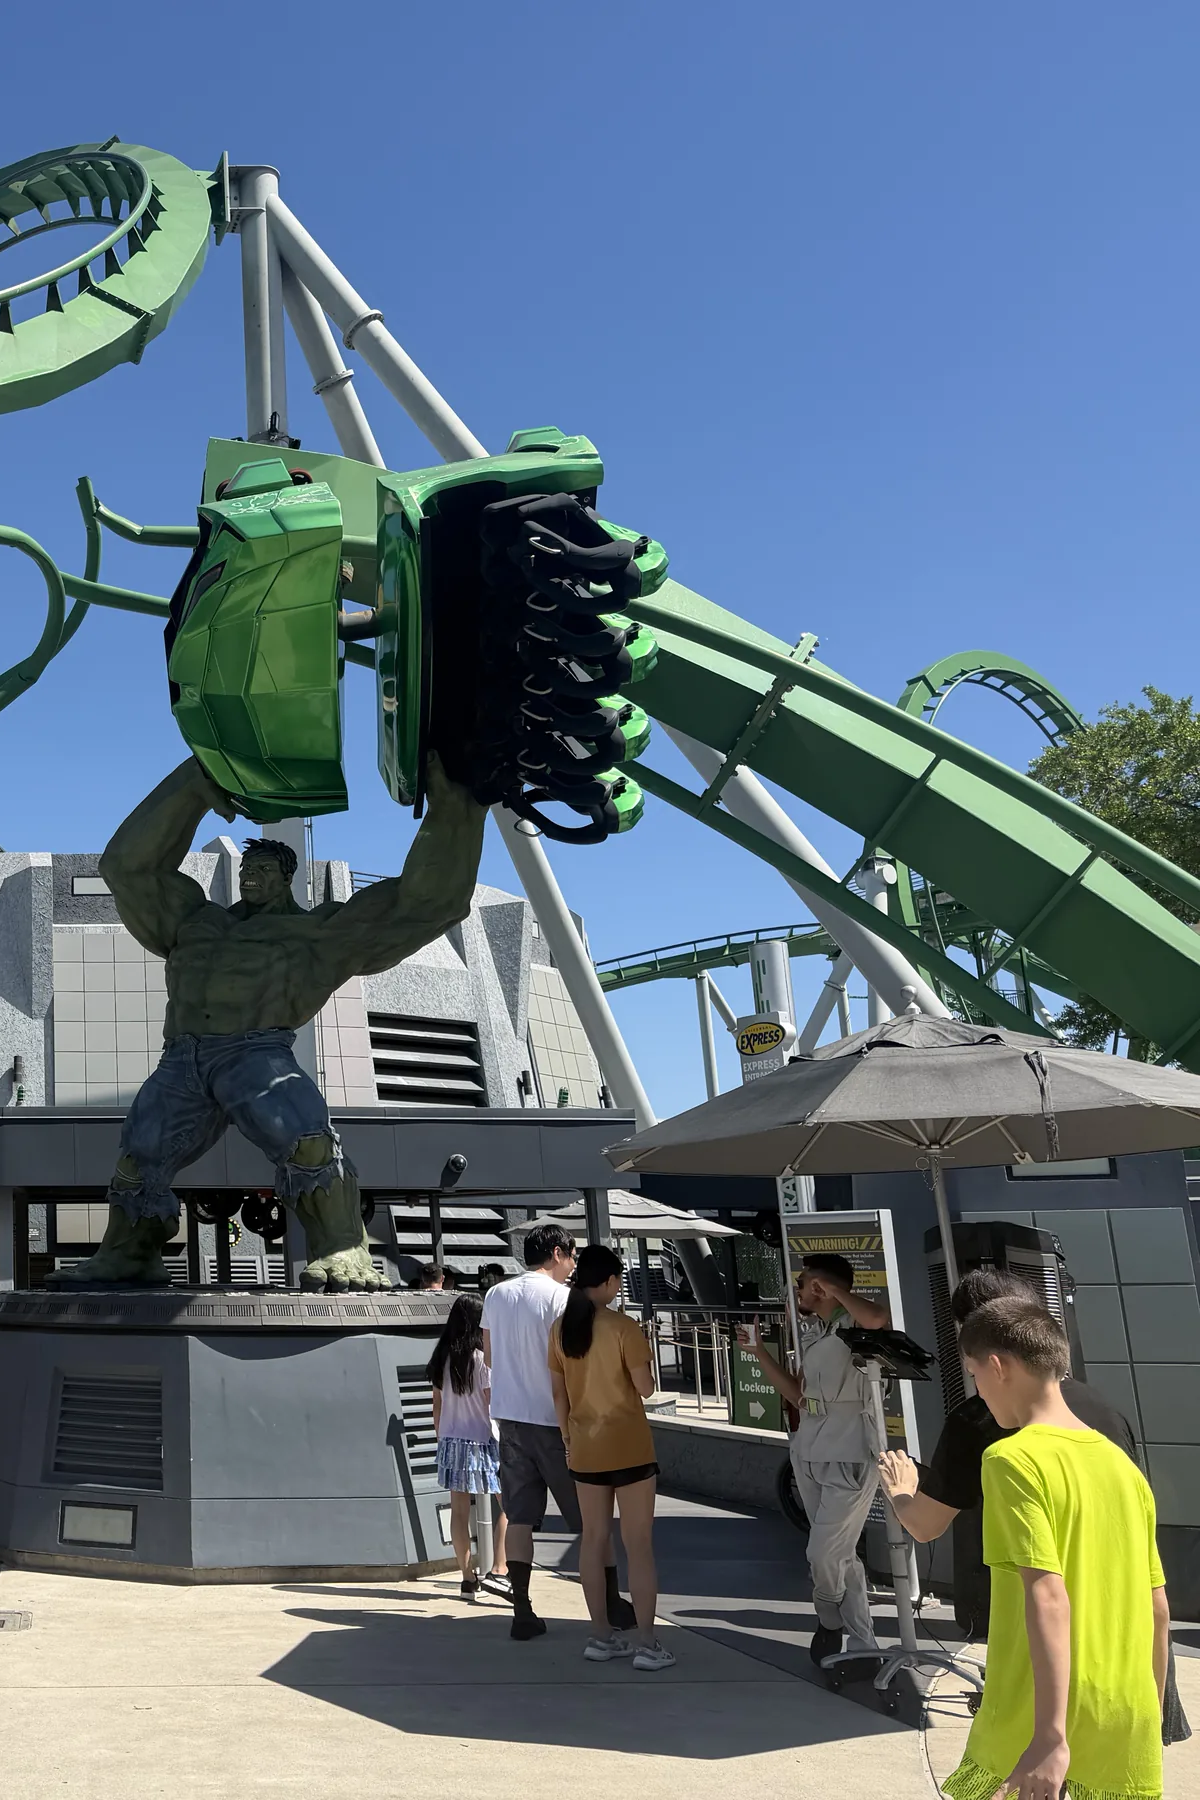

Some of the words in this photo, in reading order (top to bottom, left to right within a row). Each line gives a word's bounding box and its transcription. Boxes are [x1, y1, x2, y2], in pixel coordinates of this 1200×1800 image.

[740, 1029, 780, 1054] EXPRESS
[743, 1058, 780, 1073] EXPRESS
[809, 1237, 860, 1250] WARNING!
[751, 1366, 761, 1378] to
[740, 1381, 775, 1394] Lockers
